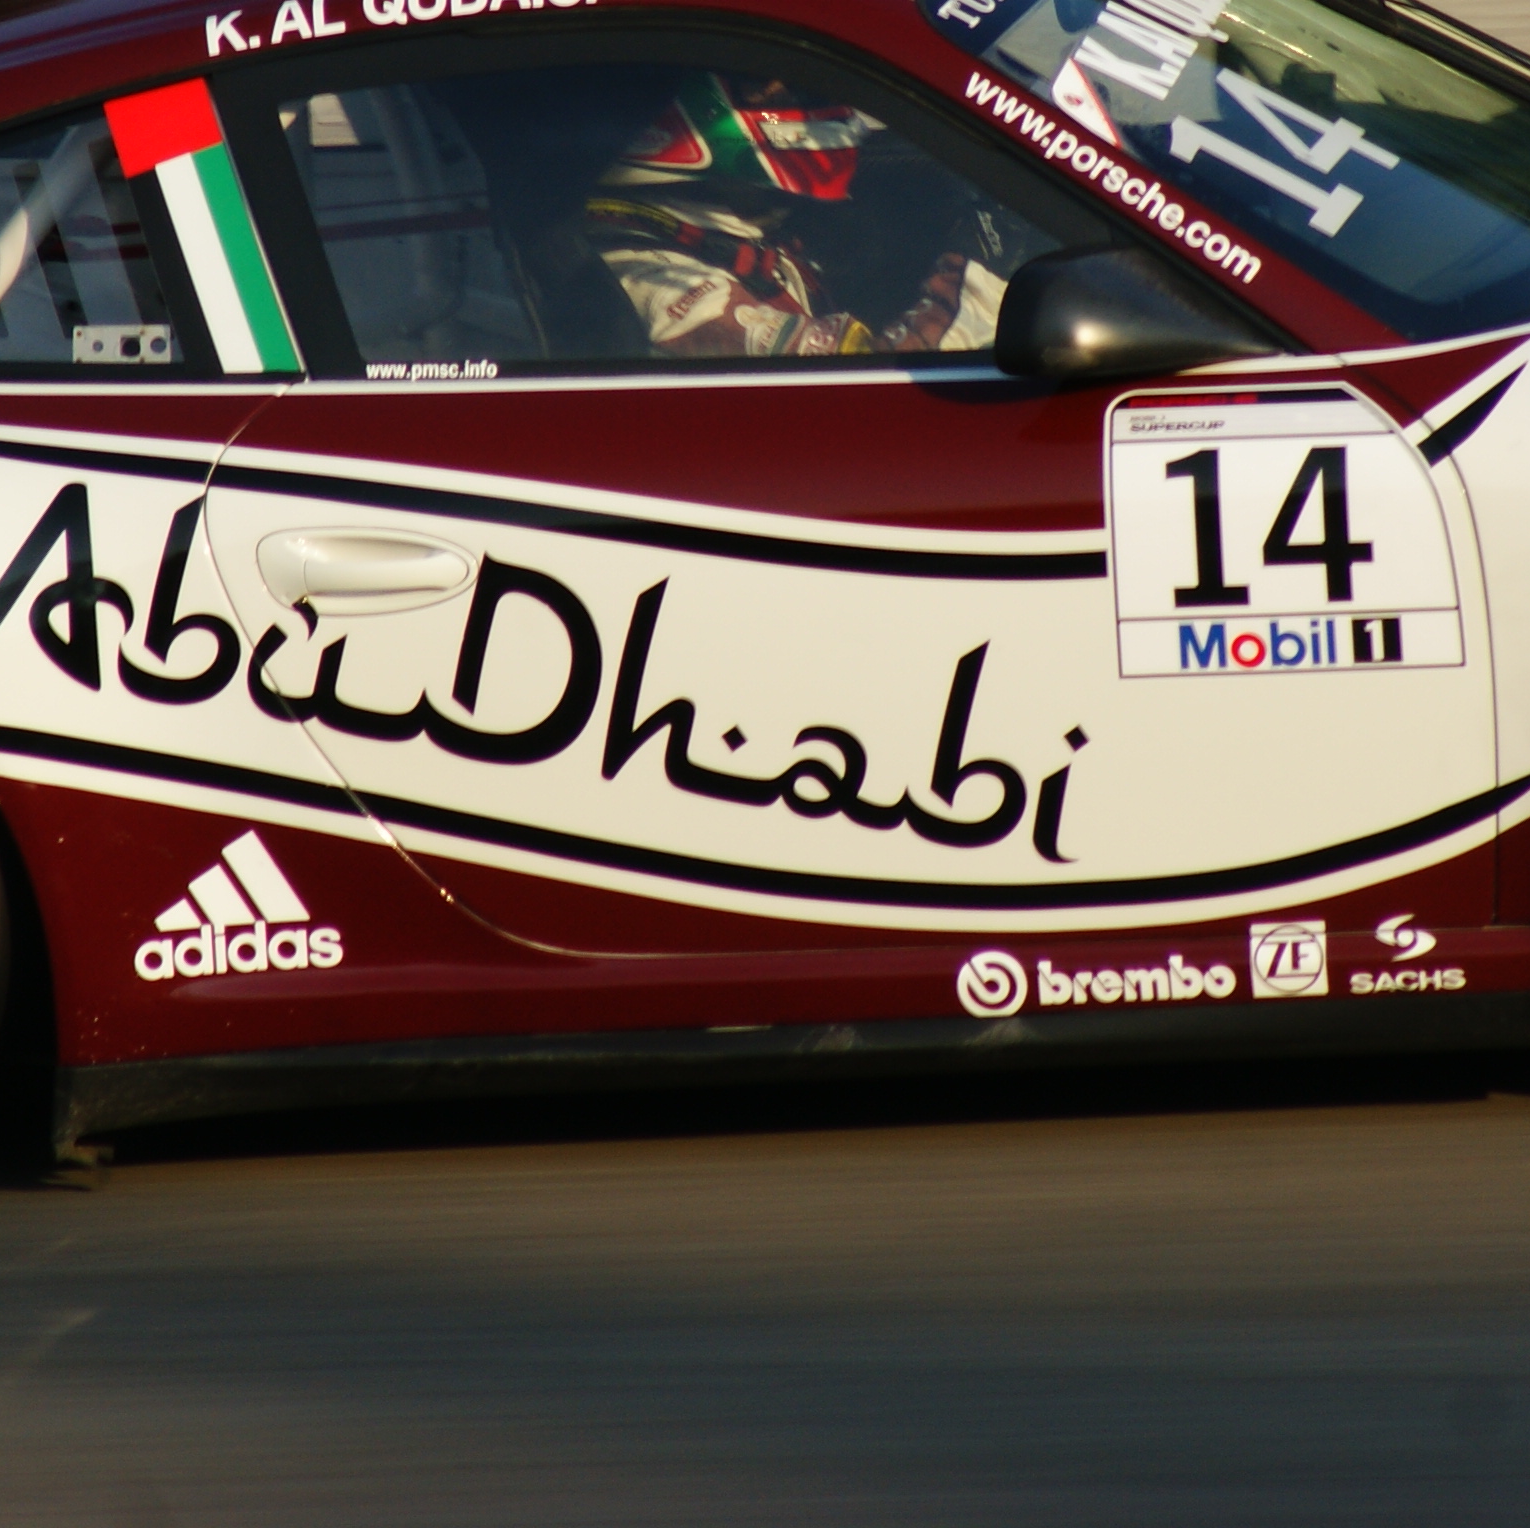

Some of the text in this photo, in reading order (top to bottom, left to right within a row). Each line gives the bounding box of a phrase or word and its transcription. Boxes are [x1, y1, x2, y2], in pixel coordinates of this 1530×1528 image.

[964, 71, 1262, 284] www.porsche.com
[1169, 67, 1400, 238] 14
[366, 359, 498, 382] www.pmsc.info
[1129, 420, 1226, 433] SUPERCUP
[1165, 444, 1374, 608] 14
[1179, 618, 1394, 669] Mobil 1
[134, 921, 343, 981] adidas
[1037, 955, 1236, 1005] brembo
[1350, 969, 1466, 994] SACHS
